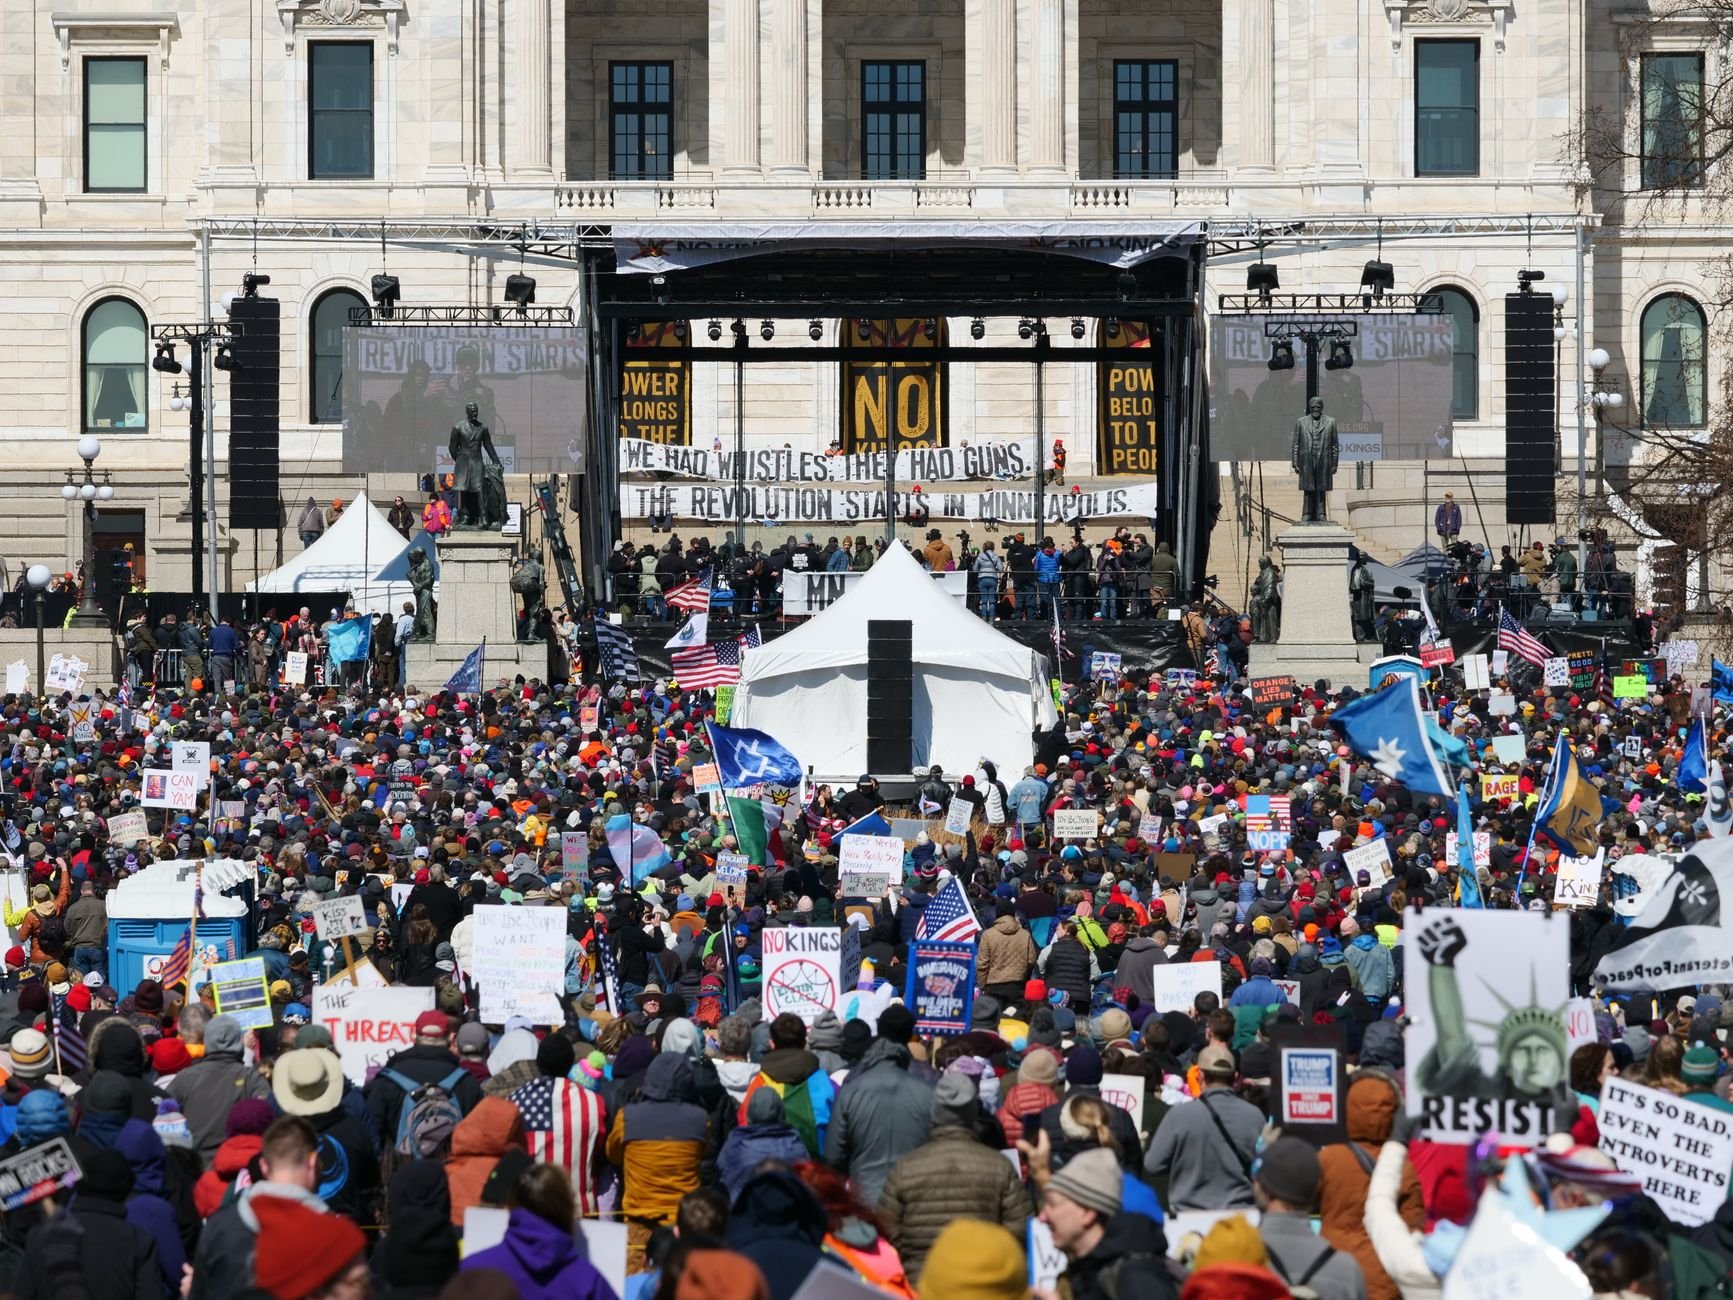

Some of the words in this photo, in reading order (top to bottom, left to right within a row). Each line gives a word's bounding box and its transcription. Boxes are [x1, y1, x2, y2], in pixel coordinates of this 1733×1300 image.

[855, 374, 929, 438] NO
[1110, 397, 1152, 416] BELO
[1110, 421, 1138, 445] TO
[1345, 443, 1381, 453] KINGS
[628, 440, 654, 468] WE
[665, 448, 708, 477] HAD
[910, 449, 954, 480] HAD
[964, 442, 1031, 478] GUNS.
[691, 487, 832, 520] REVOLUTION
[944, 493, 965, 517] IN
[1435, 640, 1450, 649] ICE
[1421, 650, 1452, 662] RESIST
[1571, 659, 1592, 668] GOOD
[1252, 677, 1290, 689] ORANGE
[1262, 686, 1280, 695] LIES
[1254, 691, 1292, 704] MATTER
[171, 774, 194, 787] CAN
[1485, 781, 1518, 796] RAGE
[171, 791, 194, 807] YAM
[1246, 831, 1291, 850] NOPE
[716, 866, 748, 878] WELCOME
[322, 906, 348, 921] KISS
[329, 918, 344, 927] MY
[325, 927, 348, 937] ASS
[494, 934, 536, 945] WANT
[916, 961, 969, 981] IMMIGRANTS
[320, 991, 354, 1010] THE
[925, 1005, 953, 1018] GREAT
[322, 1017, 417, 1044] THREAT
[366, 1052, 380, 1067] IS
[1289, 1057, 1331, 1071] TRUMP
[1291, 1101, 1331, 1116] TRUMP
[1424, 1098, 1556, 1134] RESIST
[1608, 1086, 1647, 1109] IT'S
[1653, 1100, 1679, 1119] SO
[1683, 1110, 1731, 1140] BAD,
[1603, 1110, 1661, 1141] EVEN
[1673, 1133, 1713, 1159] THE
[1600, 1136, 1726, 1187] NTROVERTS
[1646, 1176, 1702, 1206] HERE
